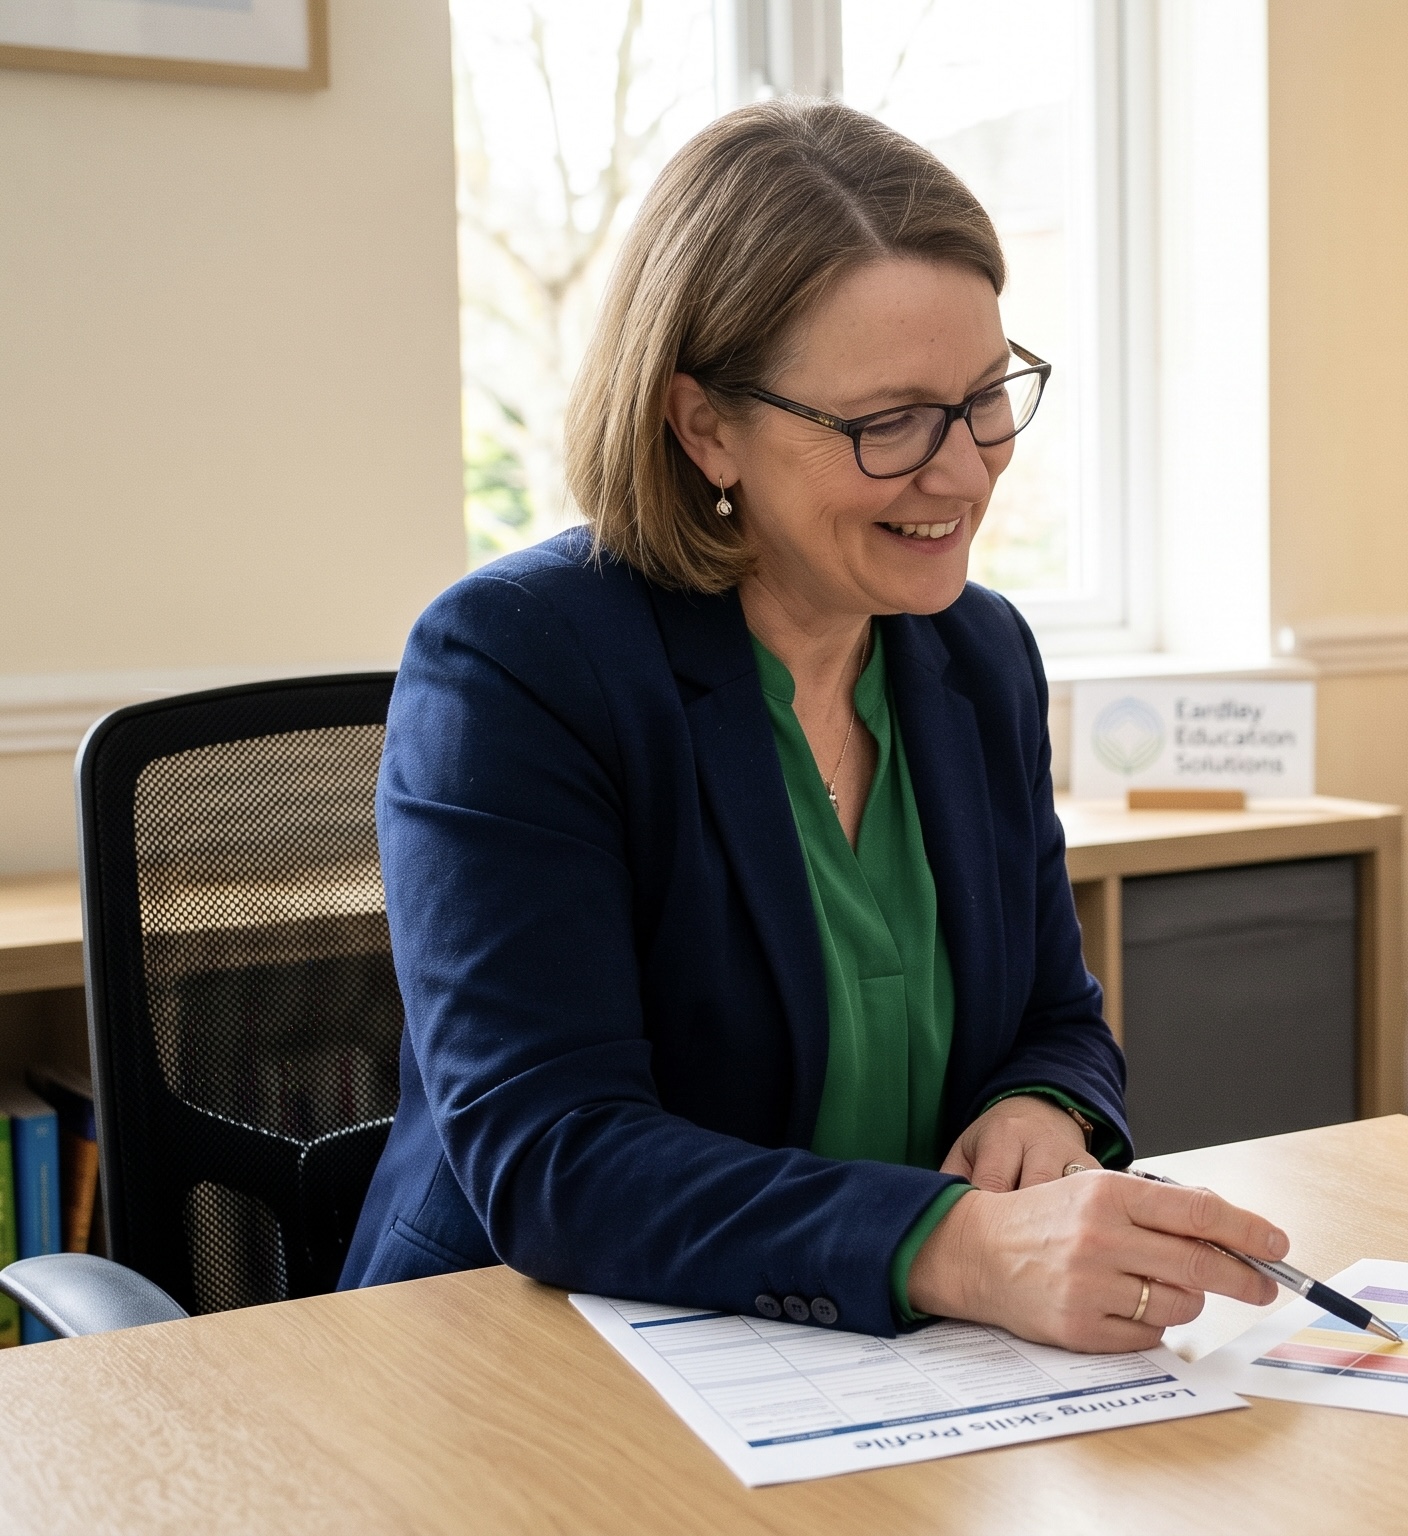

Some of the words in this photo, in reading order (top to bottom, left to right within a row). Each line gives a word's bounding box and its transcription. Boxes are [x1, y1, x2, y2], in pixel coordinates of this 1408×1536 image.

[1174, 726, 1296, 747] Education
[1174, 754, 1284, 776] Solutions
[1057, 1388, 1196, 1416] Learning
[969, 1411, 1054, 1433] Skills
[855, 1427, 963, 1449] Profile
